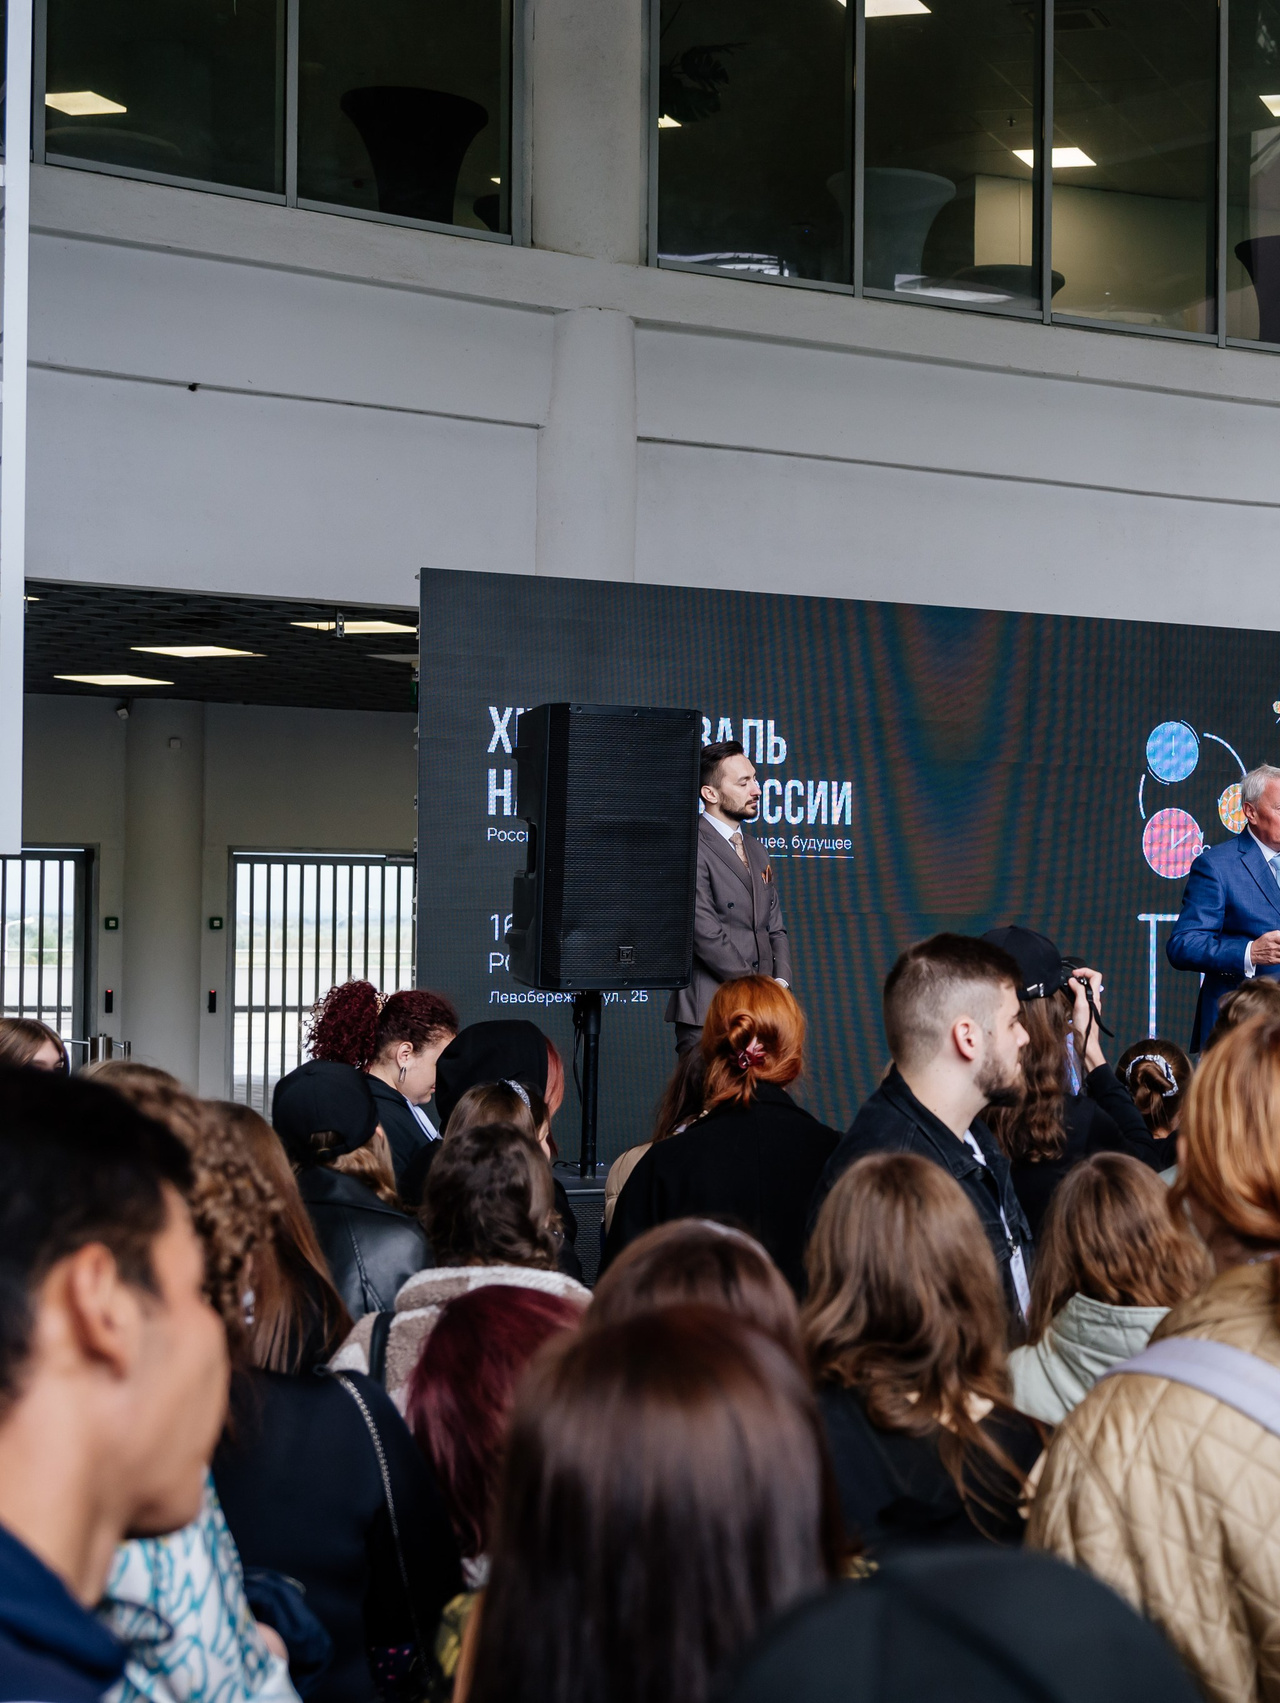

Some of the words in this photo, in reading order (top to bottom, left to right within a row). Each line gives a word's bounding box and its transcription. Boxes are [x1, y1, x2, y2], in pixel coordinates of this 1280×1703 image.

[487, 827, 529, 842] Росс
[791, 835, 852, 852] будущее
[630, 990, 649, 1003] 2Б
